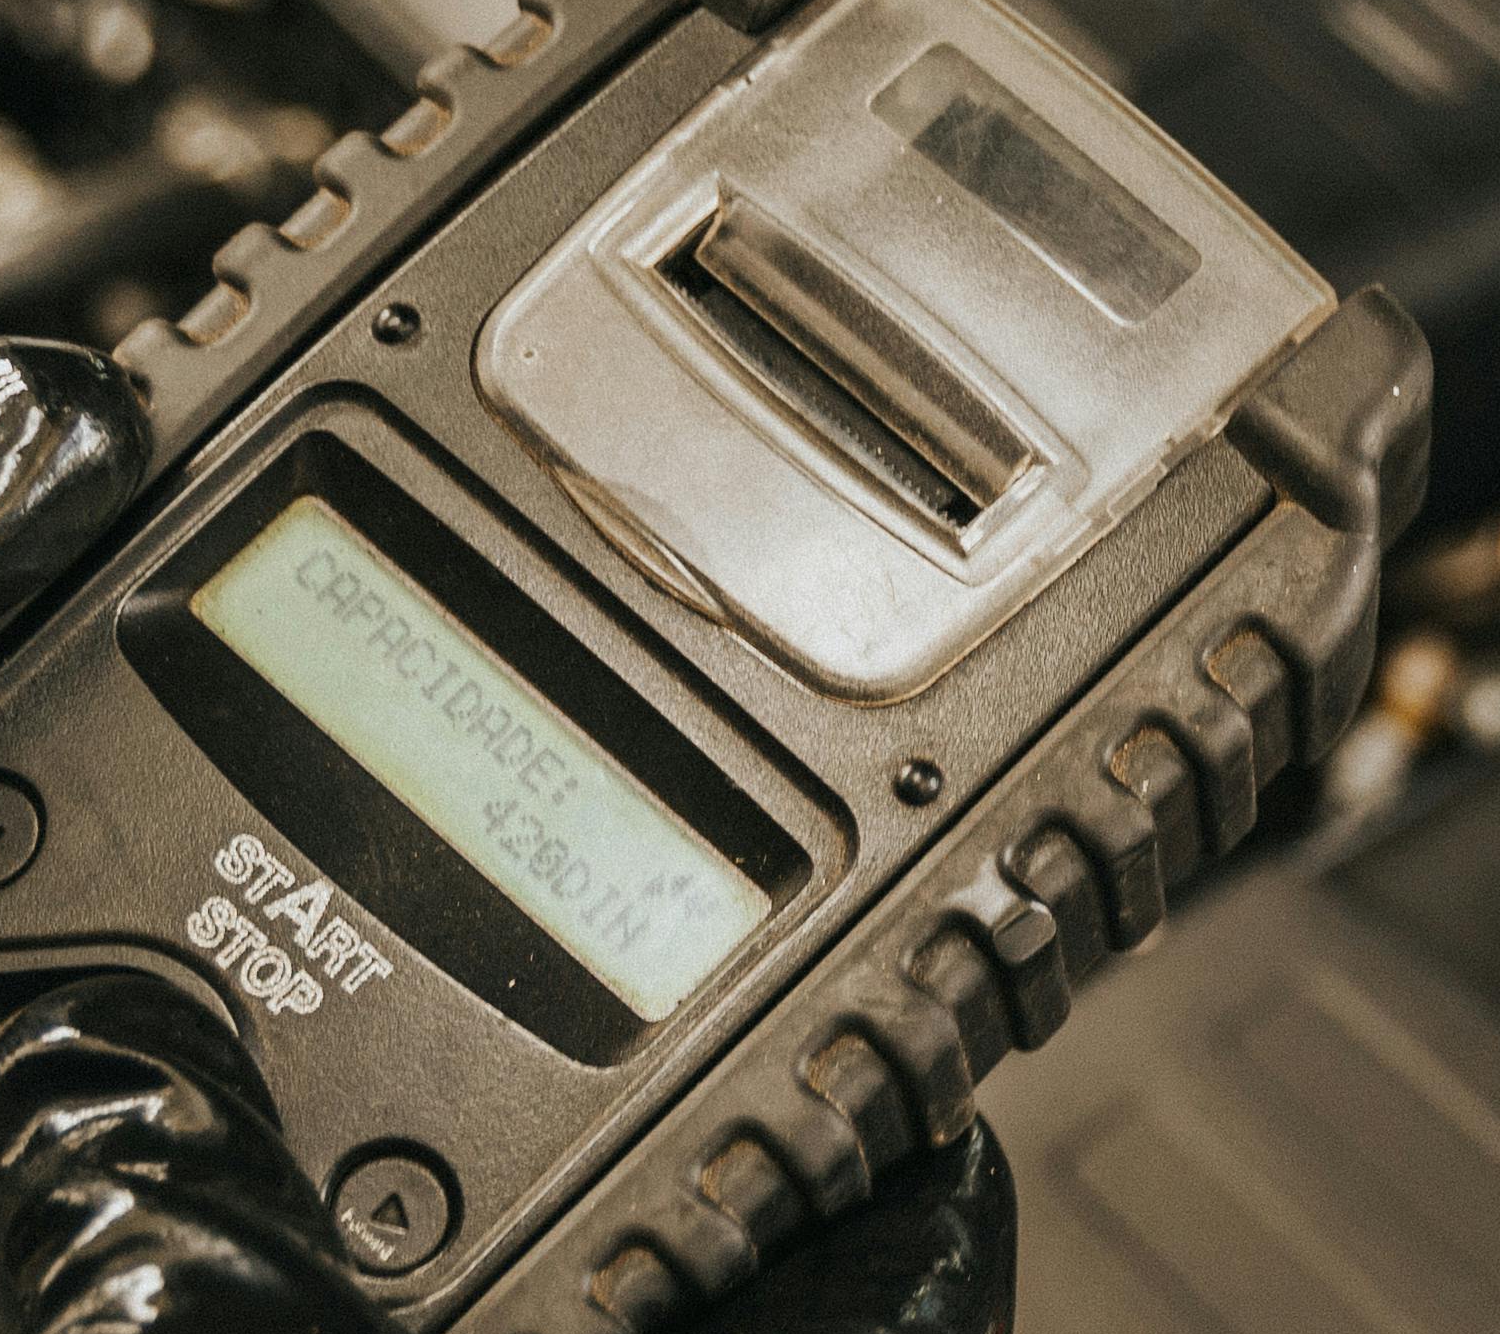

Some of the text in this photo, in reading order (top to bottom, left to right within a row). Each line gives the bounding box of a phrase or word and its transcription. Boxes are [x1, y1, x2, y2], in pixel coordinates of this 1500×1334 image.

[293, 545, 581, 808] CAPACIDADE:
[186, 896, 324, 1015] STOP
[216, 835, 394, 994] START
